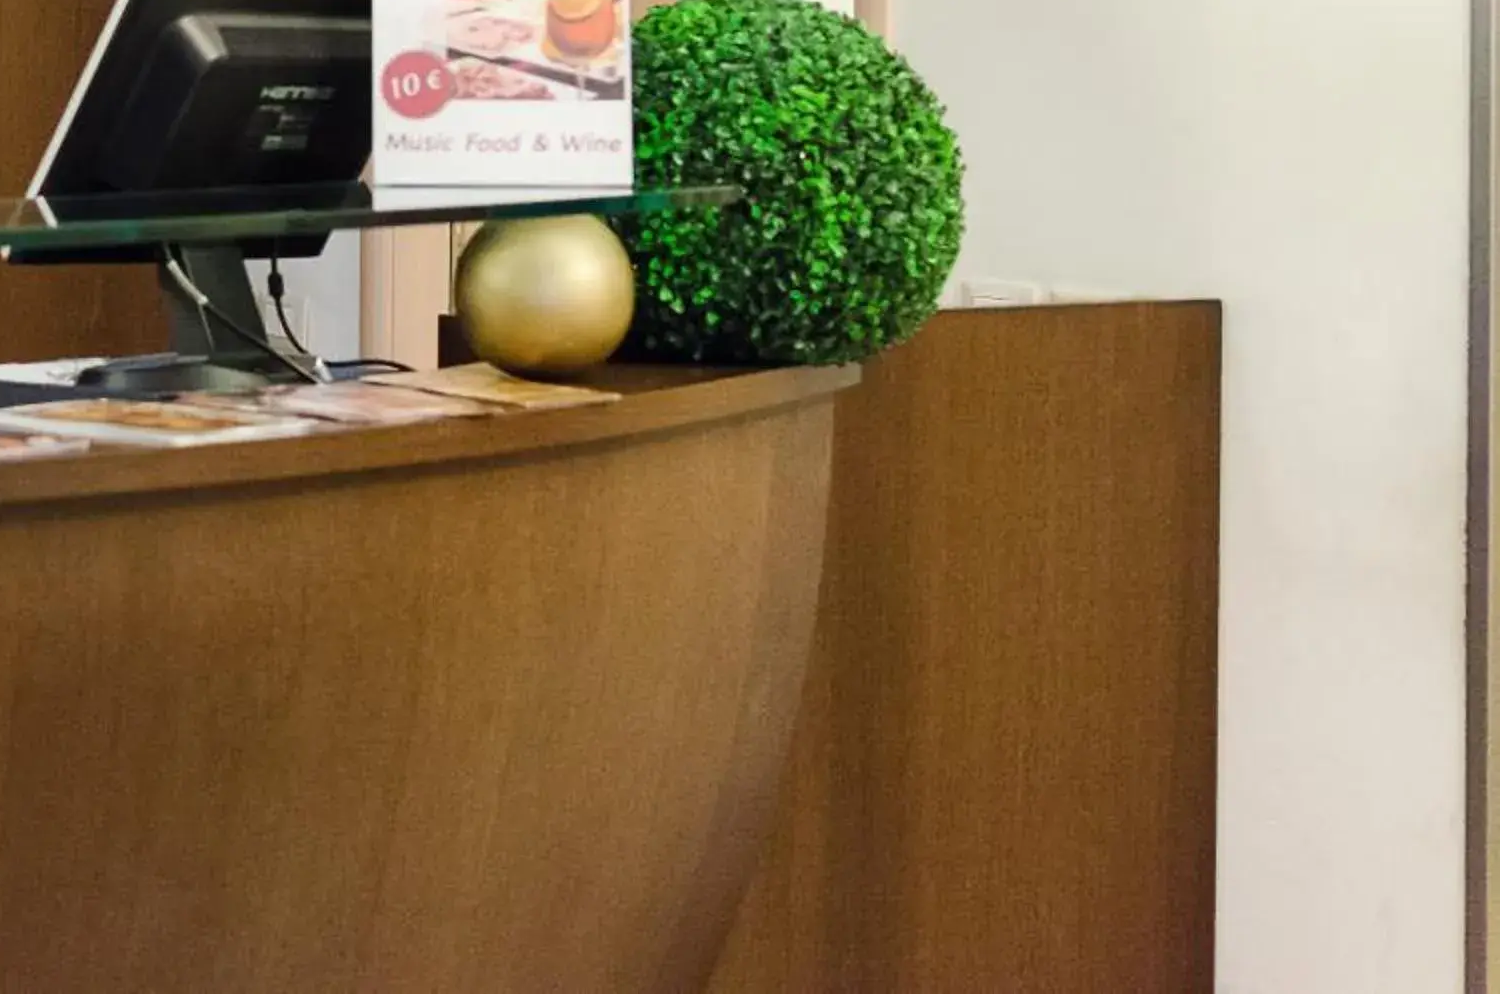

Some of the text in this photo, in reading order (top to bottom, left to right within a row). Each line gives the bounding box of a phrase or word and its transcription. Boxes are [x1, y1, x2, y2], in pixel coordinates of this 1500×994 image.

[390, 68, 443, 99] 10 €
[385, 131, 623, 153] Music Food & Wine
